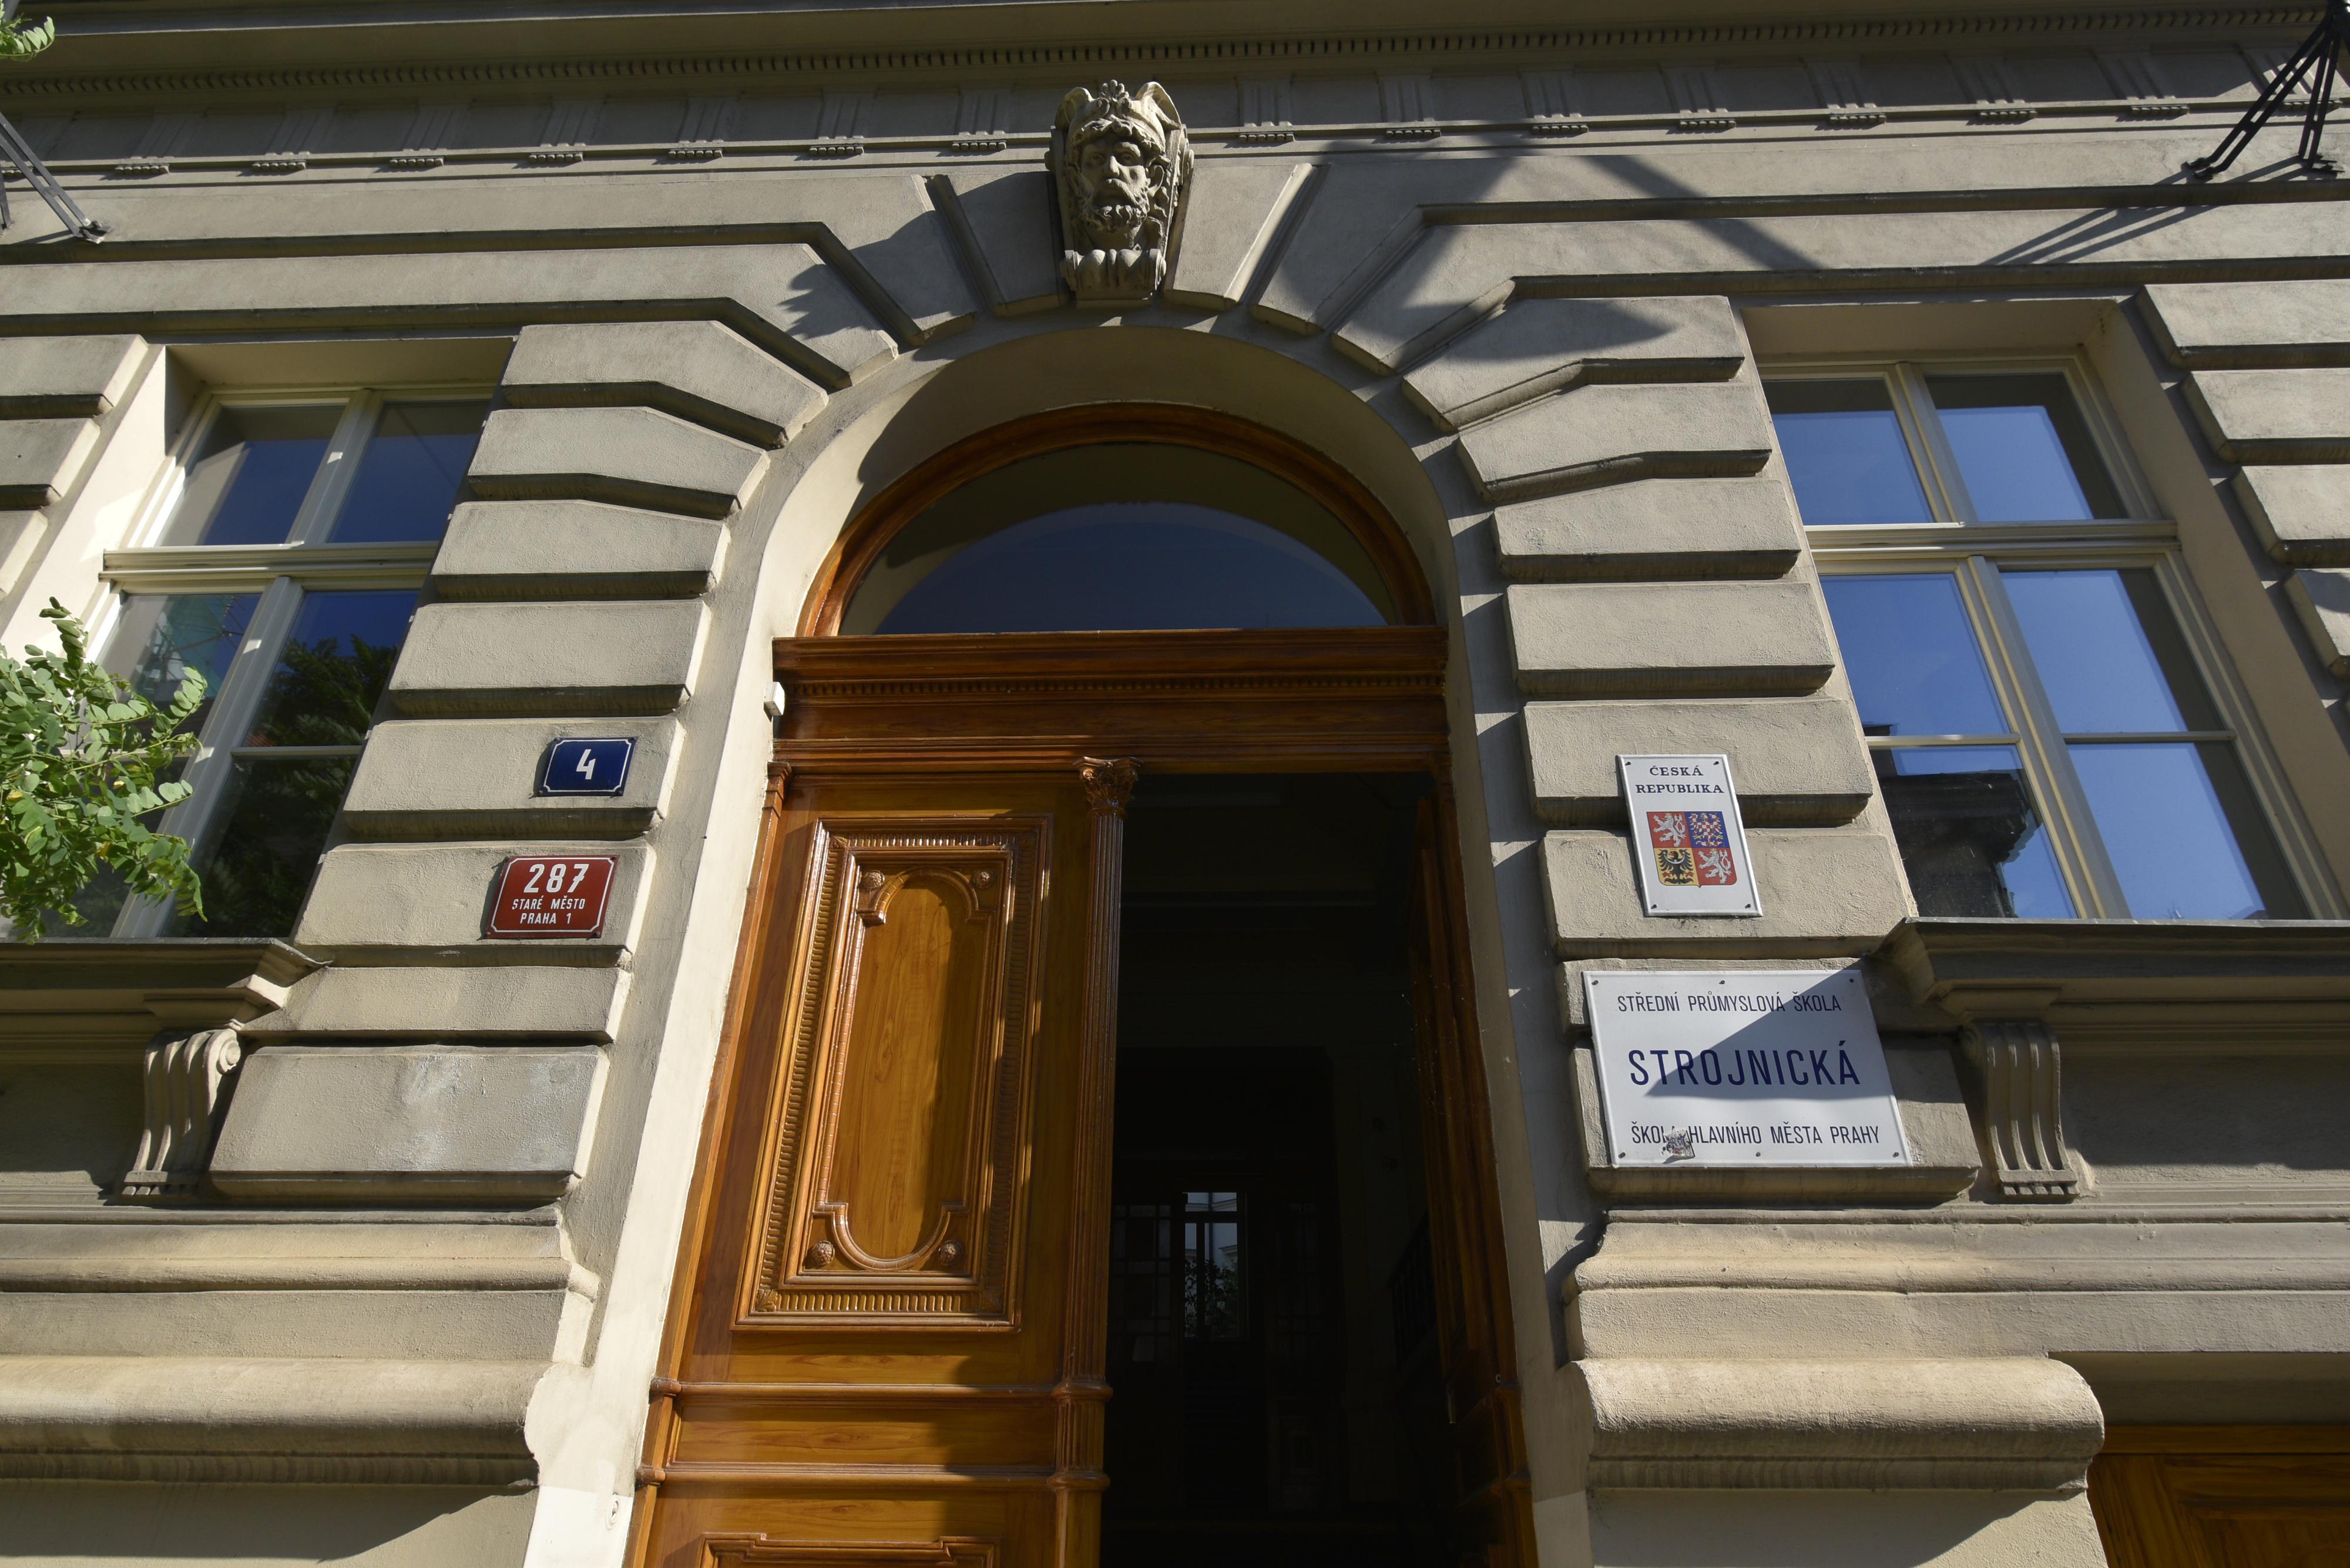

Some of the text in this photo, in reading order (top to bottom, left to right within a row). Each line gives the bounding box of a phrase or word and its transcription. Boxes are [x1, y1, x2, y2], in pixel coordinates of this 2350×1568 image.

[576, 748, 596, 780] 4
[1649, 765, 1704, 776] ČESKÁ
[1635, 784, 1725, 794] REPUBLIKA
[523, 863, 590, 894] 287
[512, 895, 586, 910] STARÉ MĚSTO
[519, 912, 572, 925] PRAHA 1
[1617, 991, 1842, 1012] STŘEDNÍ PRŮMYSLOVÁ ŠKOLA
[1628, 1040, 1861, 1086] STROJNICKÁ
[1631, 1120, 1880, 1144] ŠKOL HLAVNÍHO MĚSTA PRAHY
